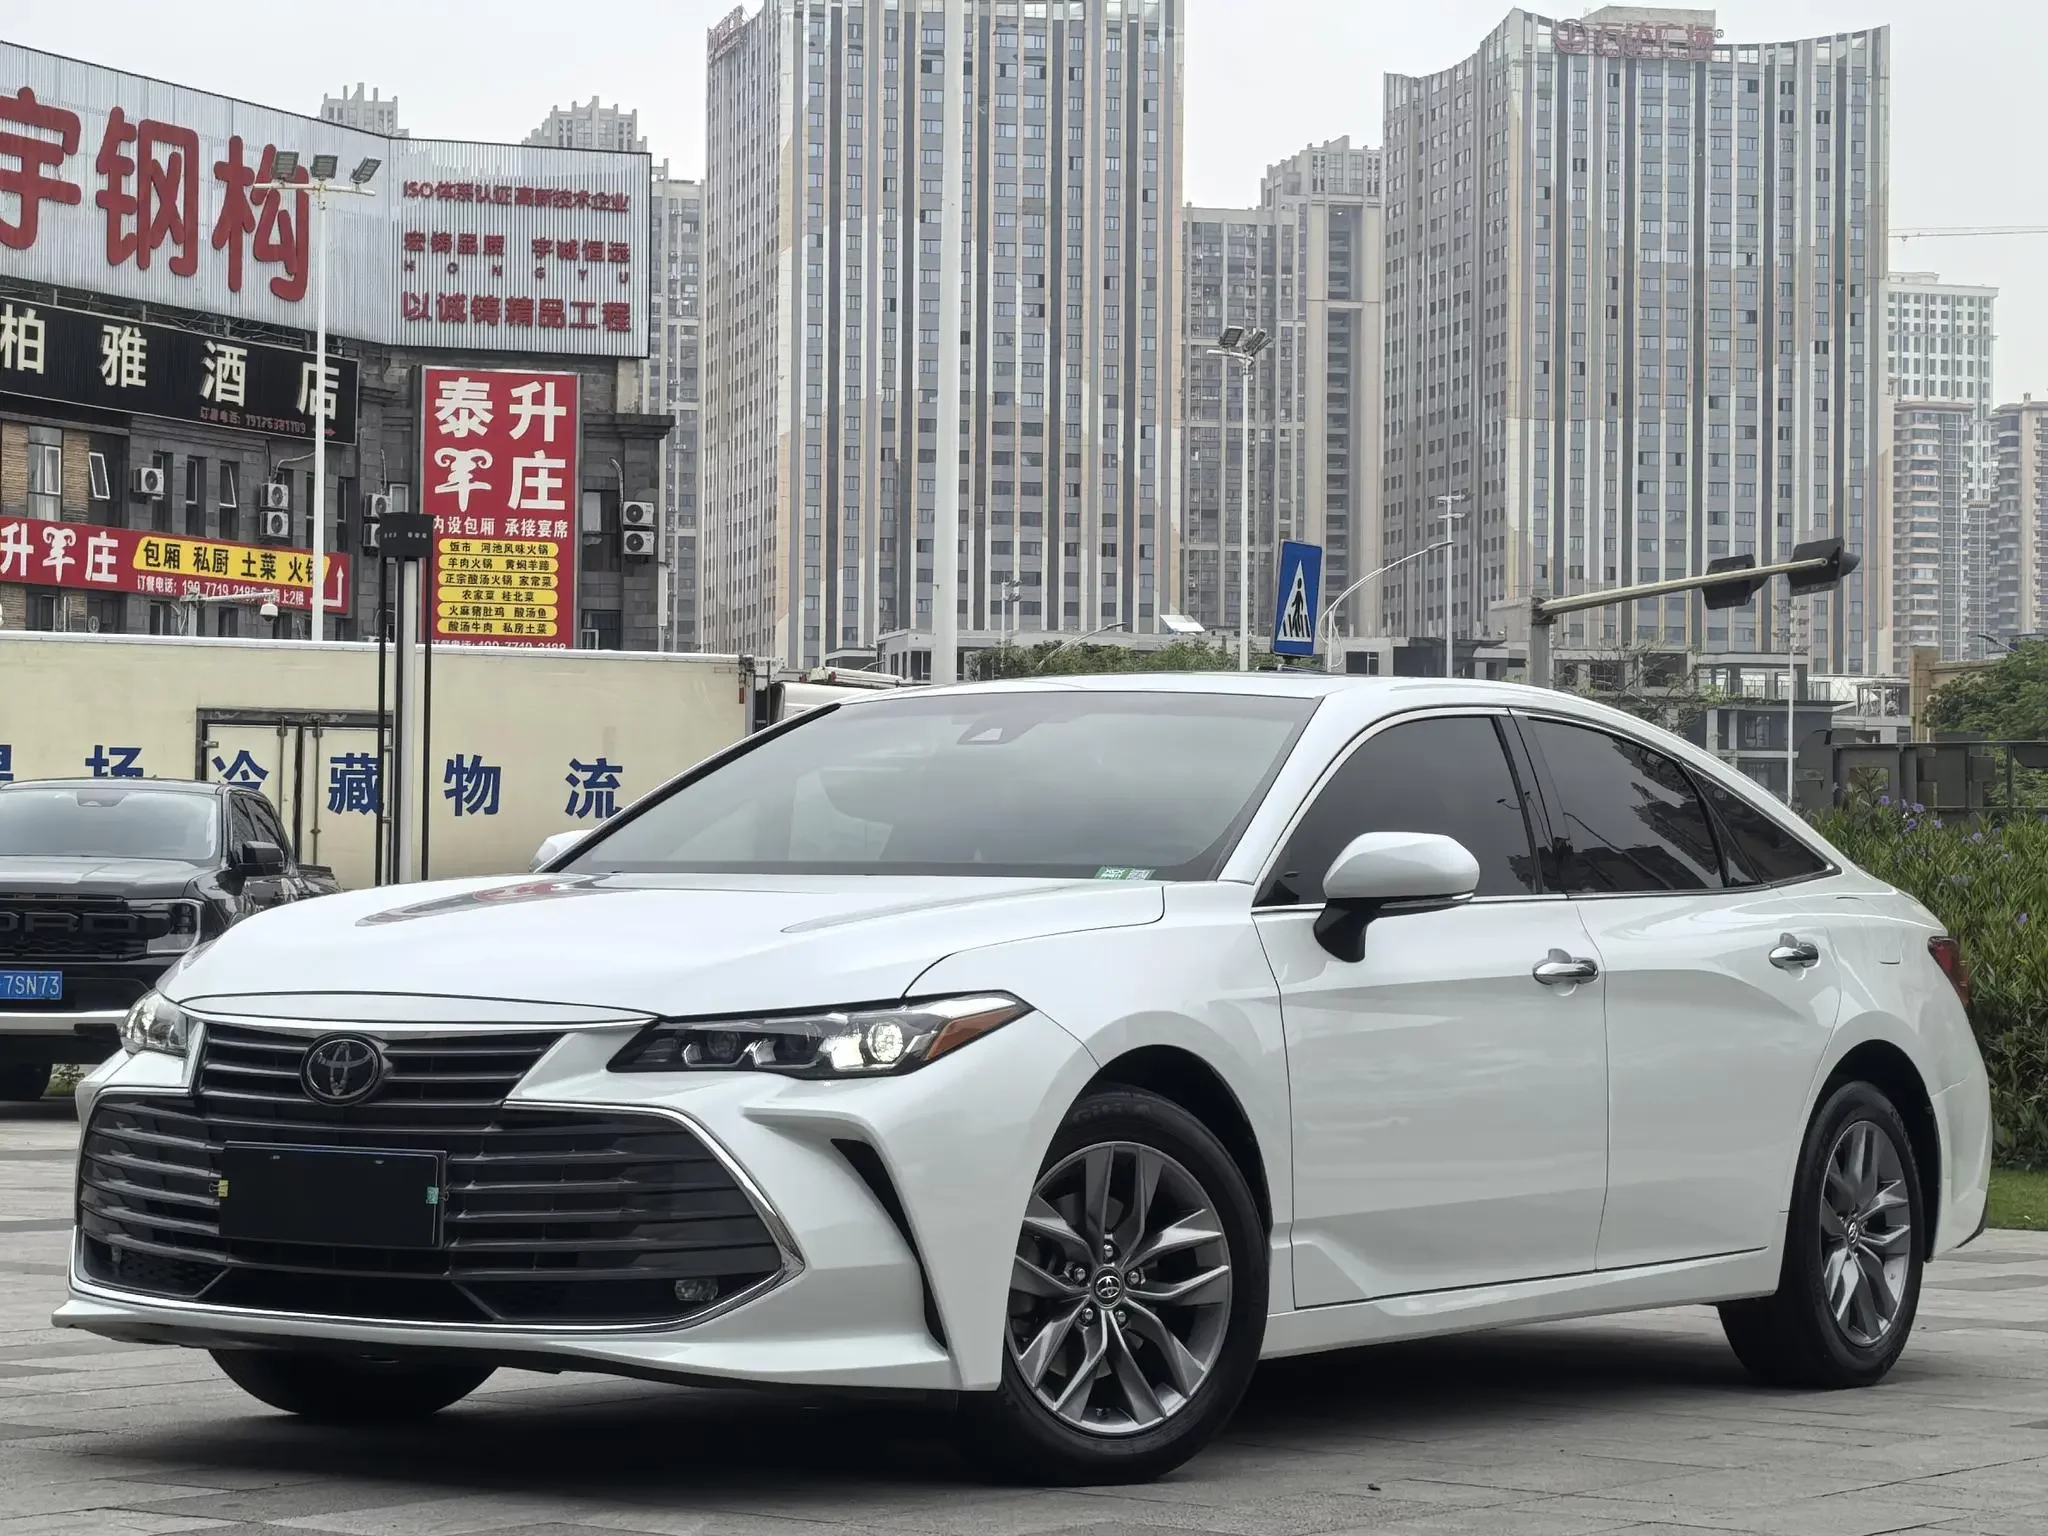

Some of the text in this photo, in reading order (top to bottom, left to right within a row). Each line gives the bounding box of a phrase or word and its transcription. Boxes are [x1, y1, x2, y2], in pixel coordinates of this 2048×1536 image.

[0, 87, 309, 301] 宇钢构
[0, 303, 340, 421] 柏雅酒店
[434, 376, 567, 442] 泰升
[433, 514, 568, 539] 内设包厢 承接宴席
[143, 539, 181, 569] 包厢
[193, 546, 229, 575] 私厨
[240, 552, 276, 580] 土菜
[448, 557, 493, 570] 羊肉火锅
[445, 573, 552, 588] 正宗酸汤火锅 家常菜
[462, 589, 535, 603] 农家菜 桂北菜
[514, 607, 547, 619] 酸汤鱼
[448, 621, 548, 635] 酸汤牛肉 私房土菜
